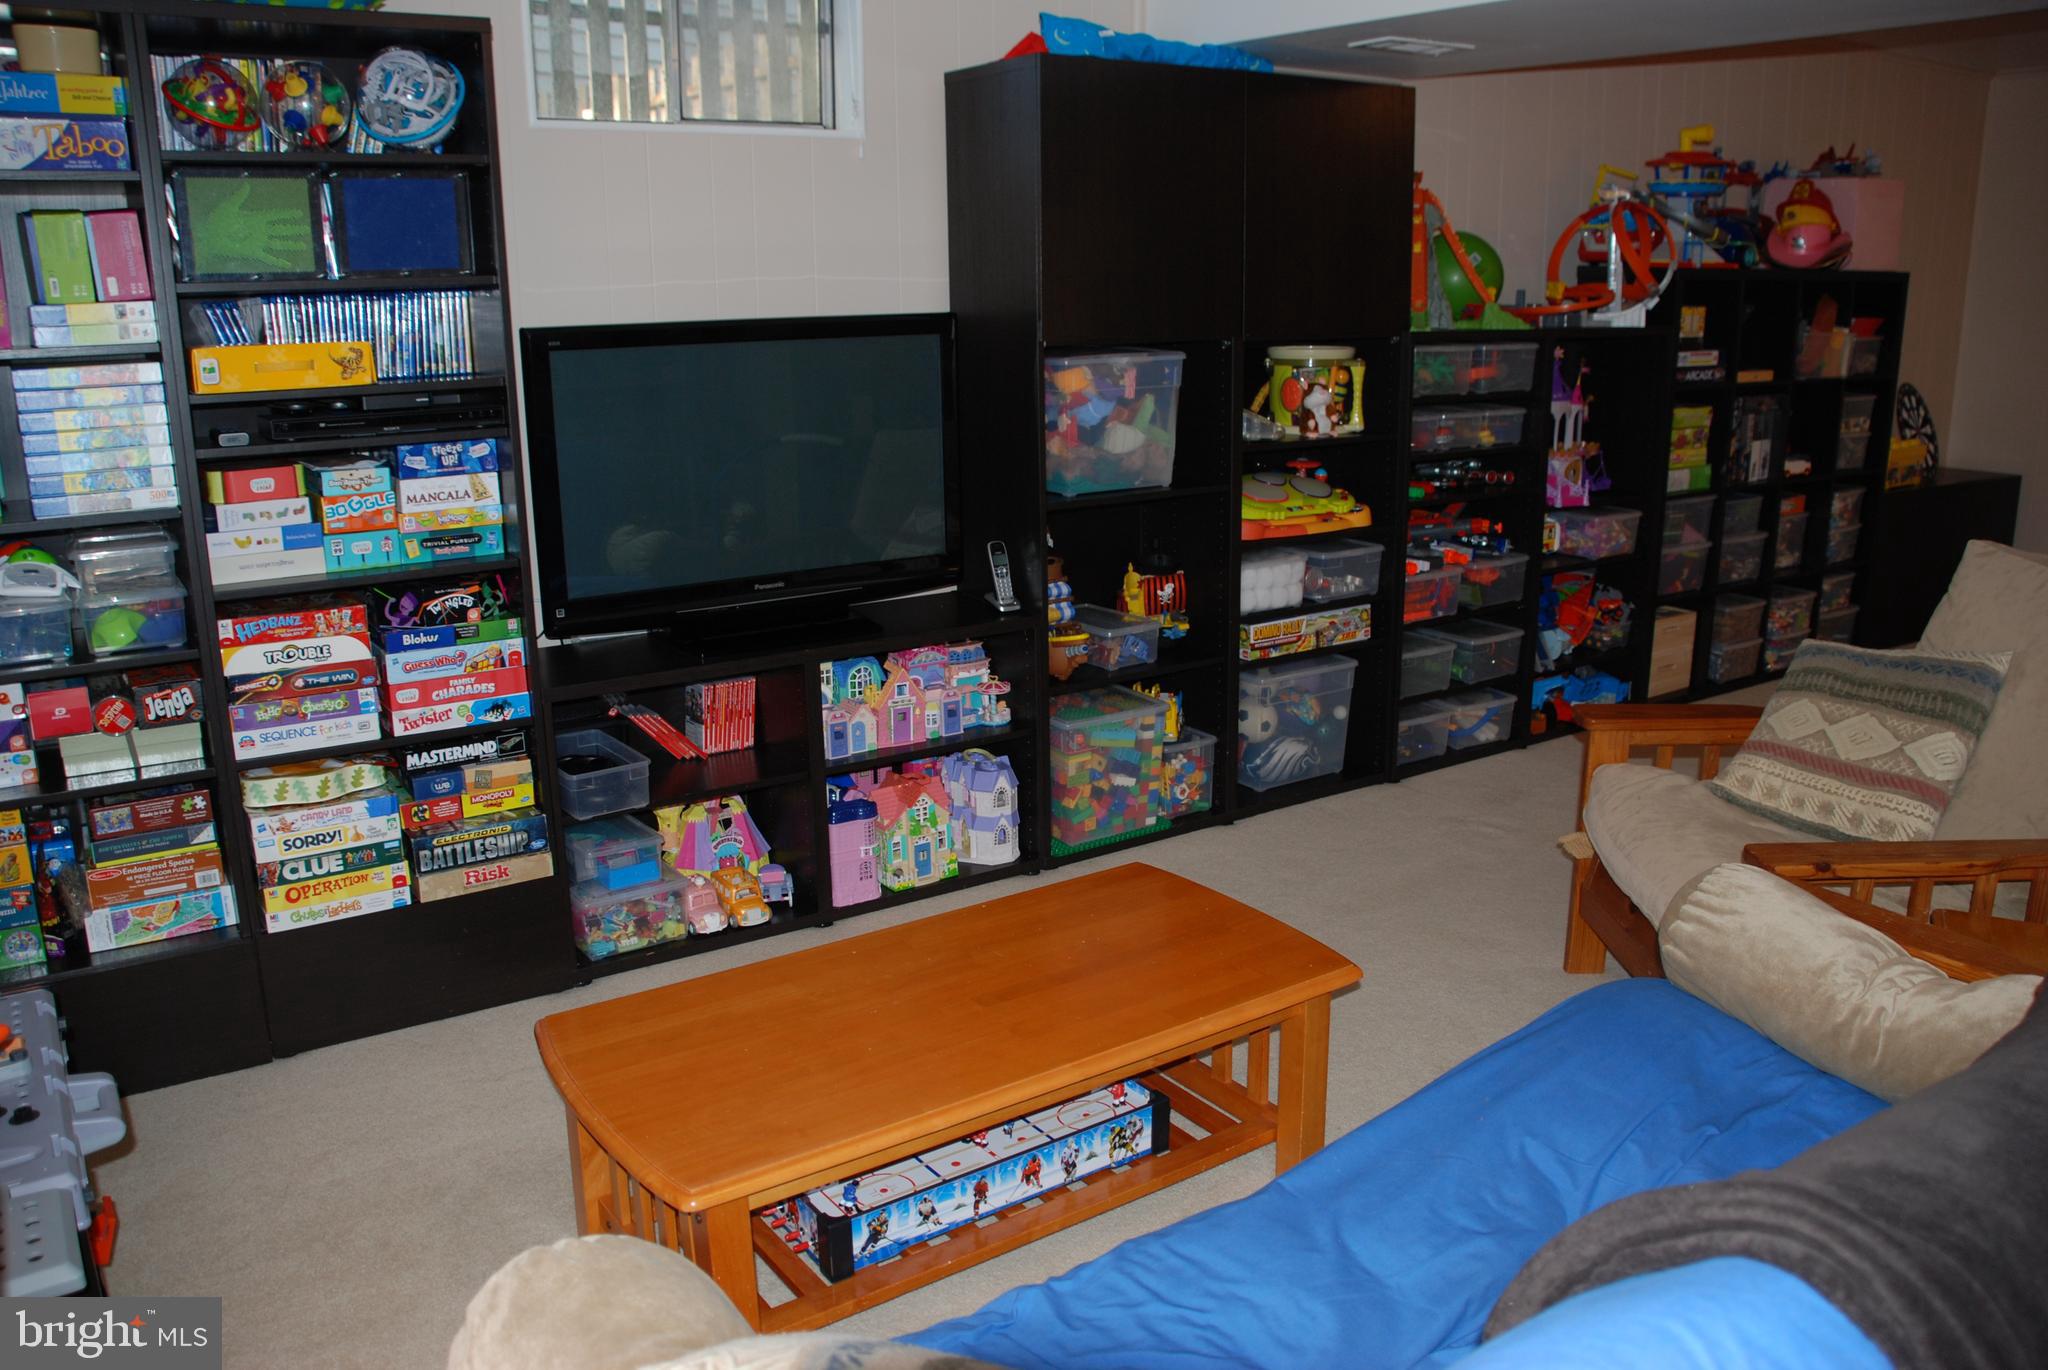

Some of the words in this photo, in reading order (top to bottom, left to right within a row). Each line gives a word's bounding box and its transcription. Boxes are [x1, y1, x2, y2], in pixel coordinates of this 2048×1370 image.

[32, 123, 125, 161] Taboo
[431, 443, 463, 456] Freeze
[406, 490, 472, 504] MANCALA
[422, 540, 449, 548] TRIVIAL
[450, 537, 480, 545] PURSUIT
[235, 615, 304, 643] HEDBANZ
[402, 632, 439, 646] Blokus
[1252, 623, 1281, 641] DOMINO
[1282, 619, 1306, 636] RALLY
[263, 645, 332, 664] TROUBLE
[403, 660, 433, 674] Guess
[434, 650, 468, 668] Who?
[306, 676, 330, 685] THE
[331, 673, 354, 683] WIN
[449, 677, 477, 687] FAMILY
[432, 683, 496, 702] CHARADES
[145, 687, 195, 721] Jenga
[399, 708, 453, 732] Twister
[259, 726, 317, 744] SEQUENCE
[319, 723, 334, 736] for
[406, 740, 497, 769] MASTERMIND
[471, 790, 513, 803] MONOPOLY
[300, 811, 329, 823] CANDY
[331, 806, 353, 818] LAND
[283, 829, 343, 852] SORRY!
[436, 826, 509, 845] ELECTRONIC
[419, 831, 529, 872] BATTLESHIP
[121, 862, 168, 876] Endangered
[168, 858, 195, 869] Species
[152, 870, 172, 878] FLOOR
[173, 866, 195, 875] PUZZLE
[282, 853, 344, 881] CLUE
[464, 865, 510, 886] Risk
[285, 873, 369, 904] OPERATION
